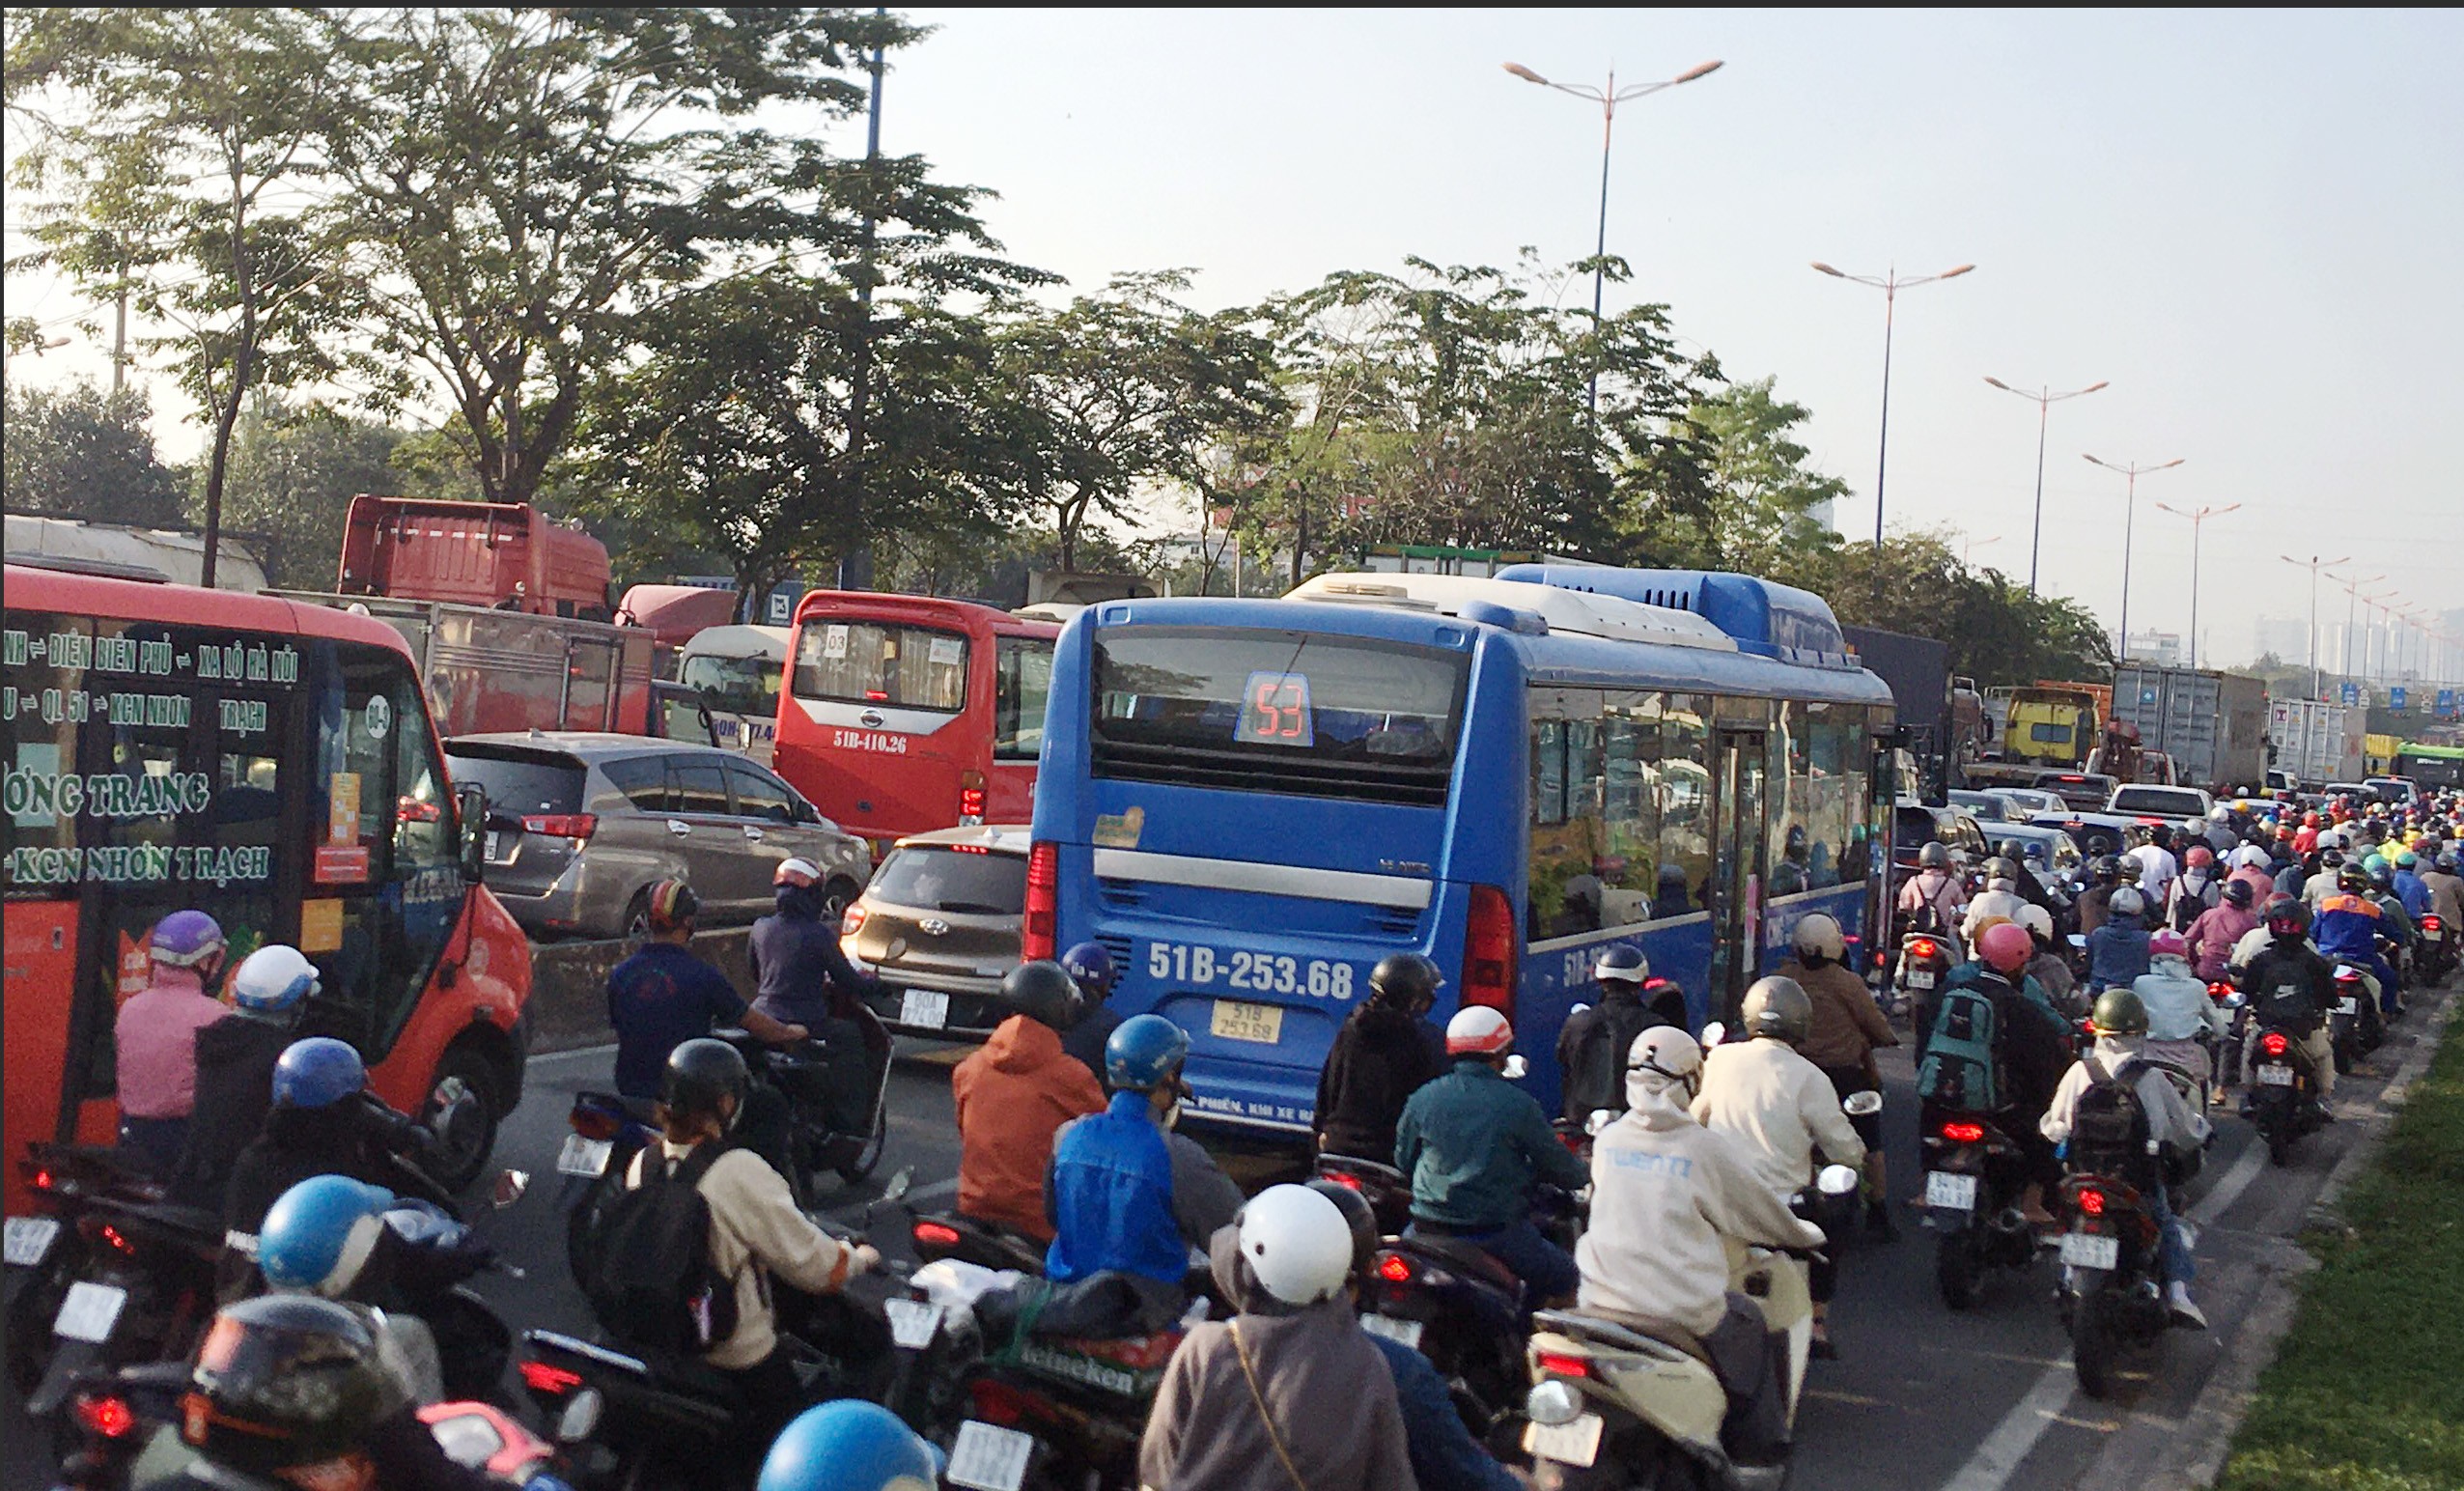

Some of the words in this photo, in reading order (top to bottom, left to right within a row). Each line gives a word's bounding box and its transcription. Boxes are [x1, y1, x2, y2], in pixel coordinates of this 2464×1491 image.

[48, 627, 92, 678] ĐIỆN
[96, 631, 136, 673] BIÊN
[140, 632, 173, 676] PHỦ
[198, 644, 221, 678] XA
[224, 639, 244, 687] LỘ
[247, 641, 268, 681] HÀ
[271, 643, 298, 690] NỘI
[42, 688, 65, 724] QL
[68, 689, 89, 723] 51
[109, 692, 145, 725] KCN
[147, 693, 191, 728] NHƠN
[219, 698, 267, 739] TRẠCH
[1257, 683, 1303, 738] 53
[833, 730, 908, 755] 51B-410.26
[88, 772, 210, 817] TRANG
[87, 840, 174, 882] NHƠN
[176, 845, 270, 888] TRẠCH
[1149, 942, 1354, 1000] 51B-253.68
[1233, 1003, 1263, 1023] 51B
